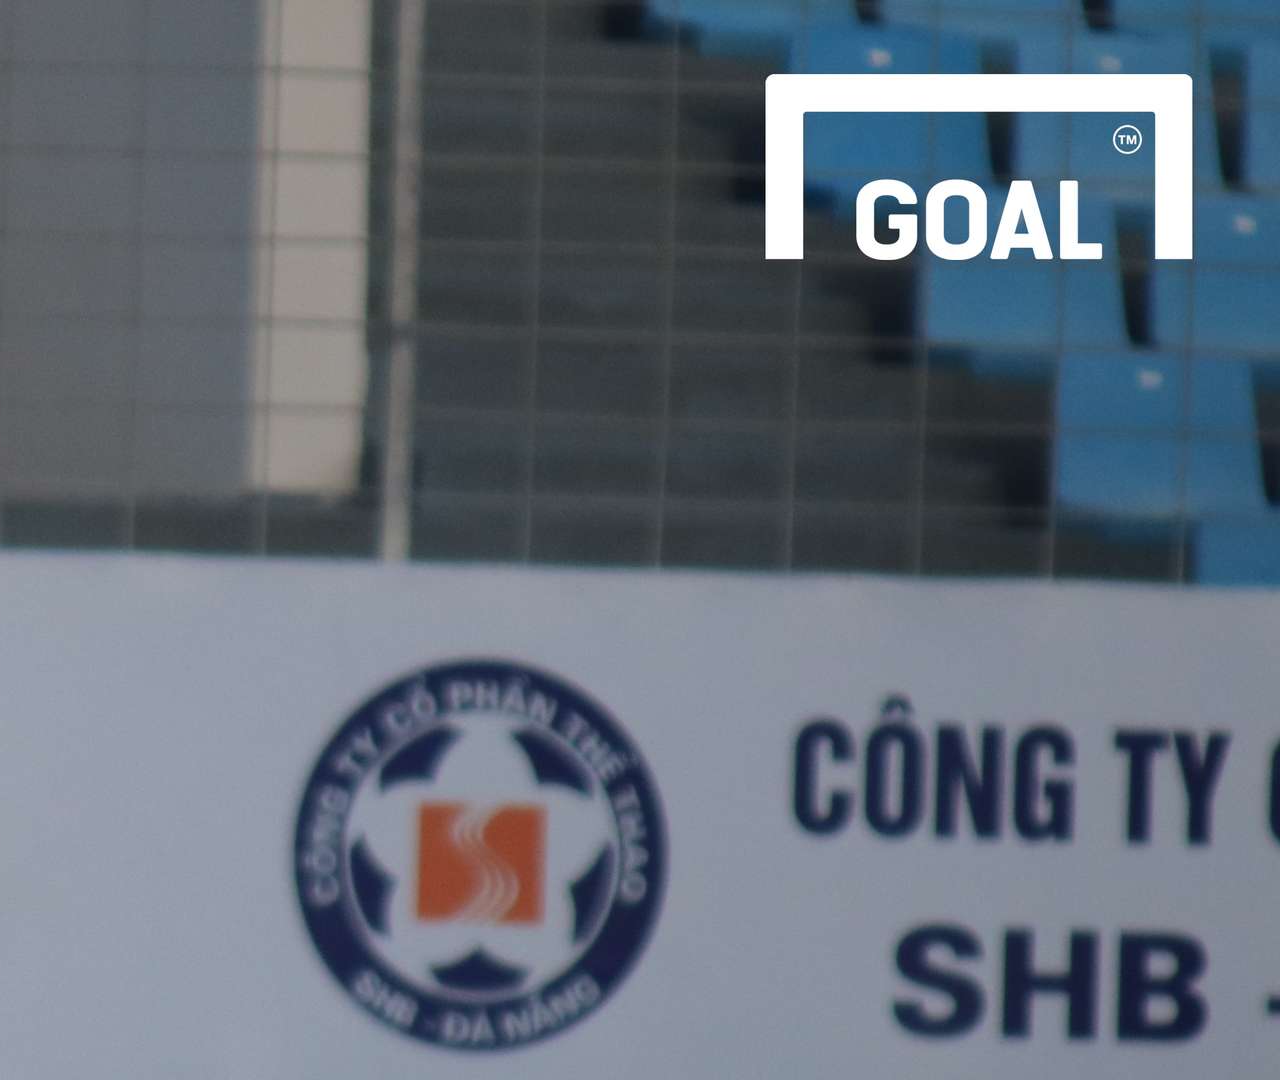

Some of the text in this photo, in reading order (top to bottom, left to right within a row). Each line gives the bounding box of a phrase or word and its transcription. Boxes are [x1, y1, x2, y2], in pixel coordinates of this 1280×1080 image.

[793, 695, 1076, 842] CÔNG
[1113, 727, 1234, 847] TY
[891, 923, 1209, 1043] SHB
